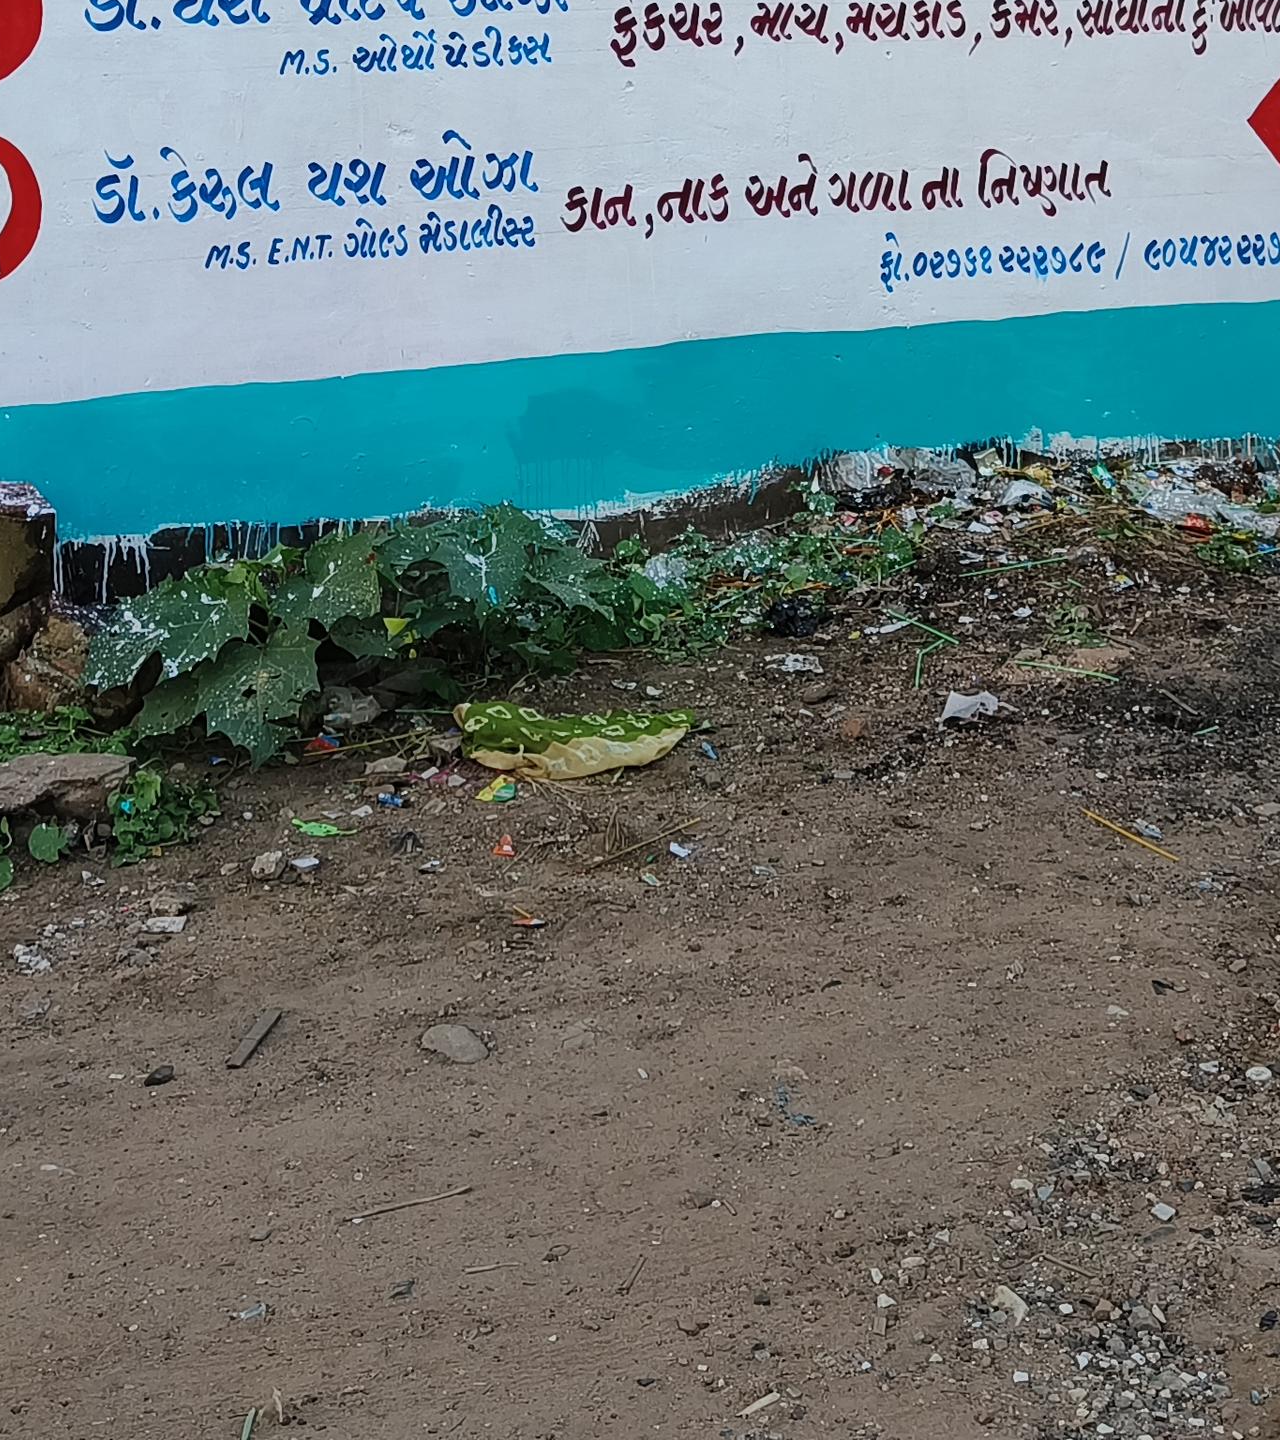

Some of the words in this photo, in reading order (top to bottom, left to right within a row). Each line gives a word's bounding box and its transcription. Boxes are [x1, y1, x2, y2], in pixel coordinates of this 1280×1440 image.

[308, 160, 386, 206] યશ
[410, 130, 538, 200] ઓઝા
[745, 153, 818, 218] અને
